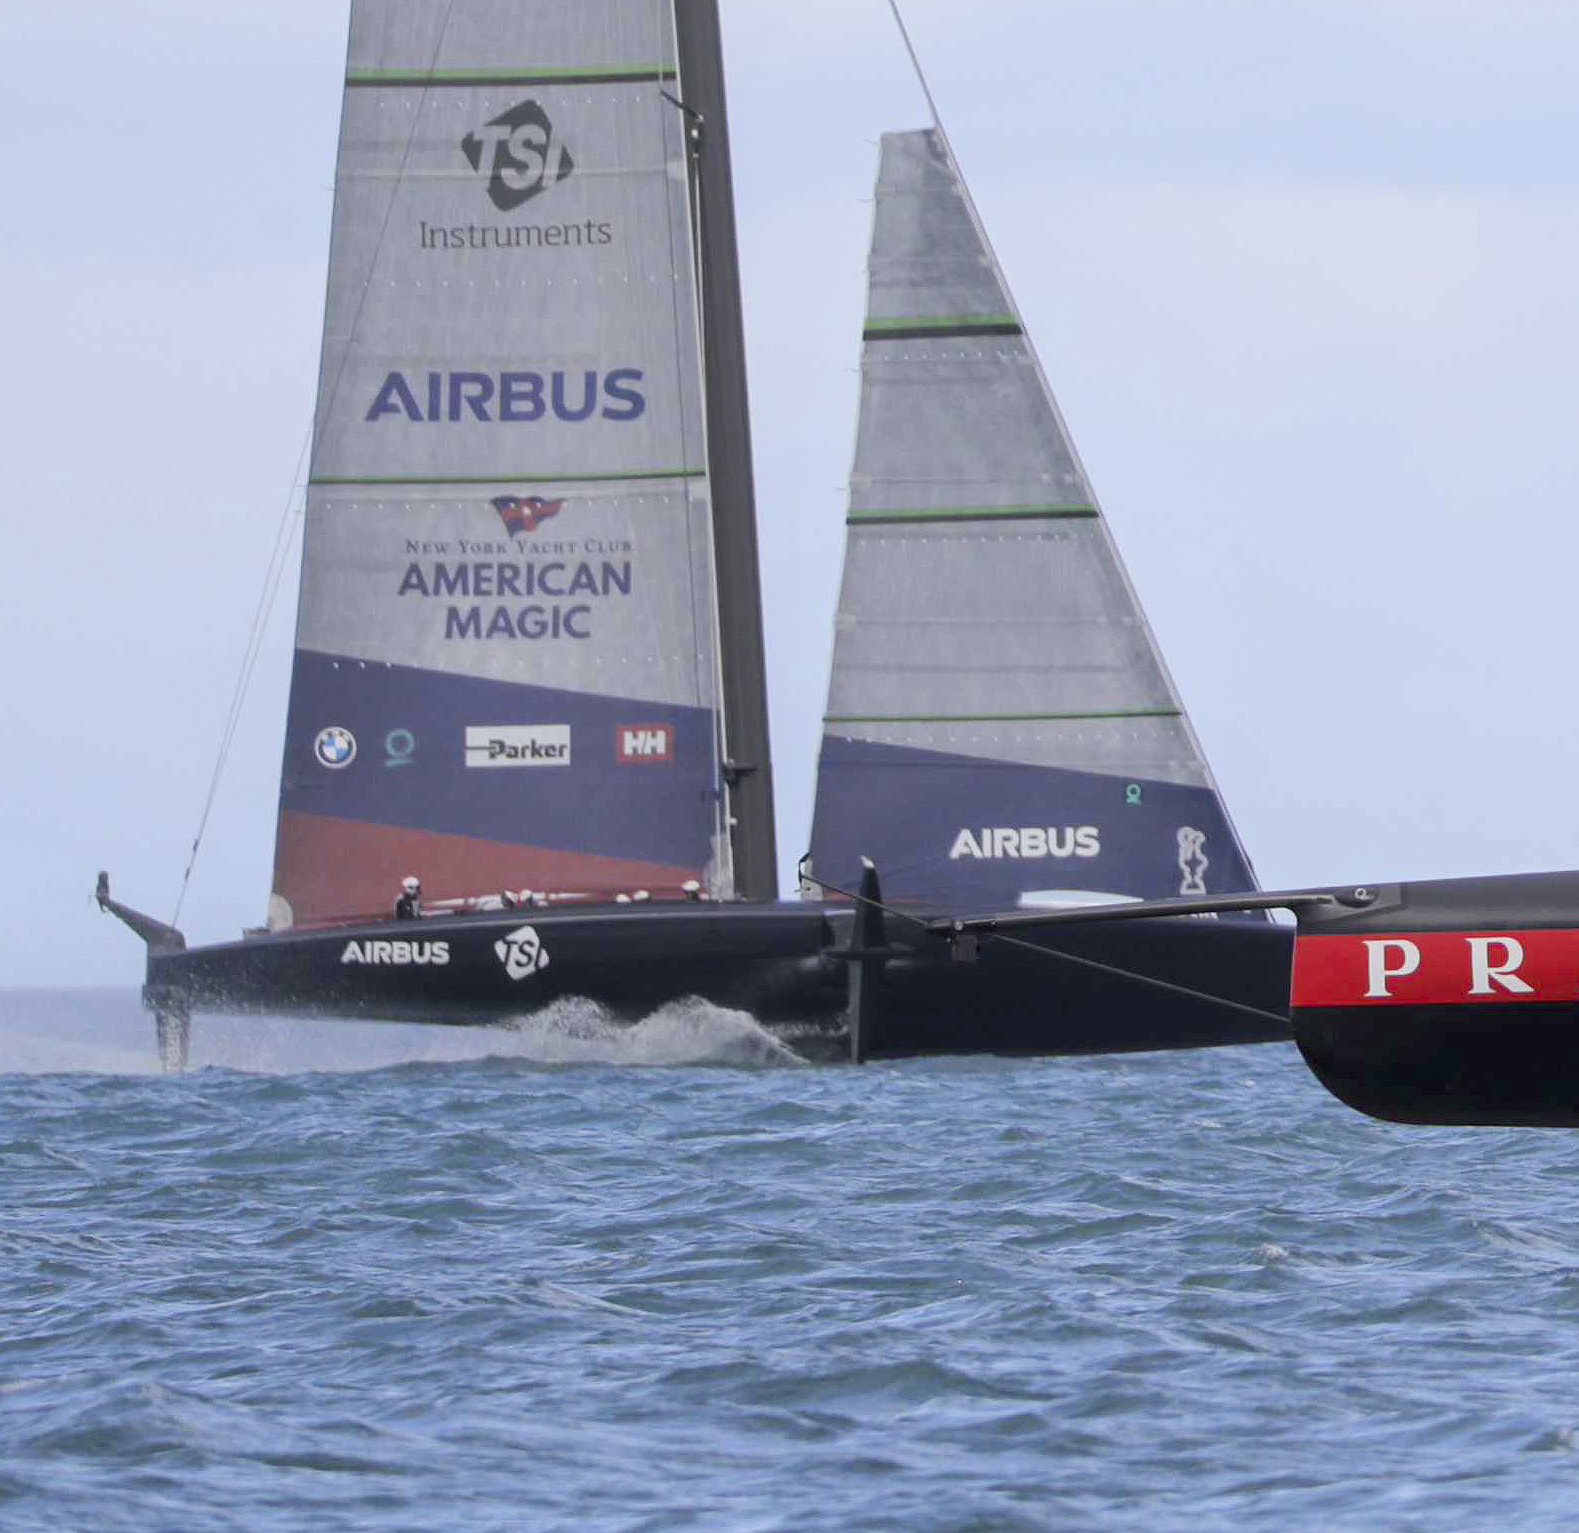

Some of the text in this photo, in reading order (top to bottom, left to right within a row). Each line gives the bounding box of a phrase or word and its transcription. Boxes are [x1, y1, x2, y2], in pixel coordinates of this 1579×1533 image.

[420, 218, 613, 250] Instruments
[364, 368, 646, 422] AIRBUS
[398, 561, 631, 597] AMERICAN
[445, 604, 591, 640] MAGIC
[487, 737, 567, 759] Parker
[623, 730, 666, 756] HH
[949, 826, 1101, 859] AIRBUS
[341, 940, 450, 966] AIRBUS
